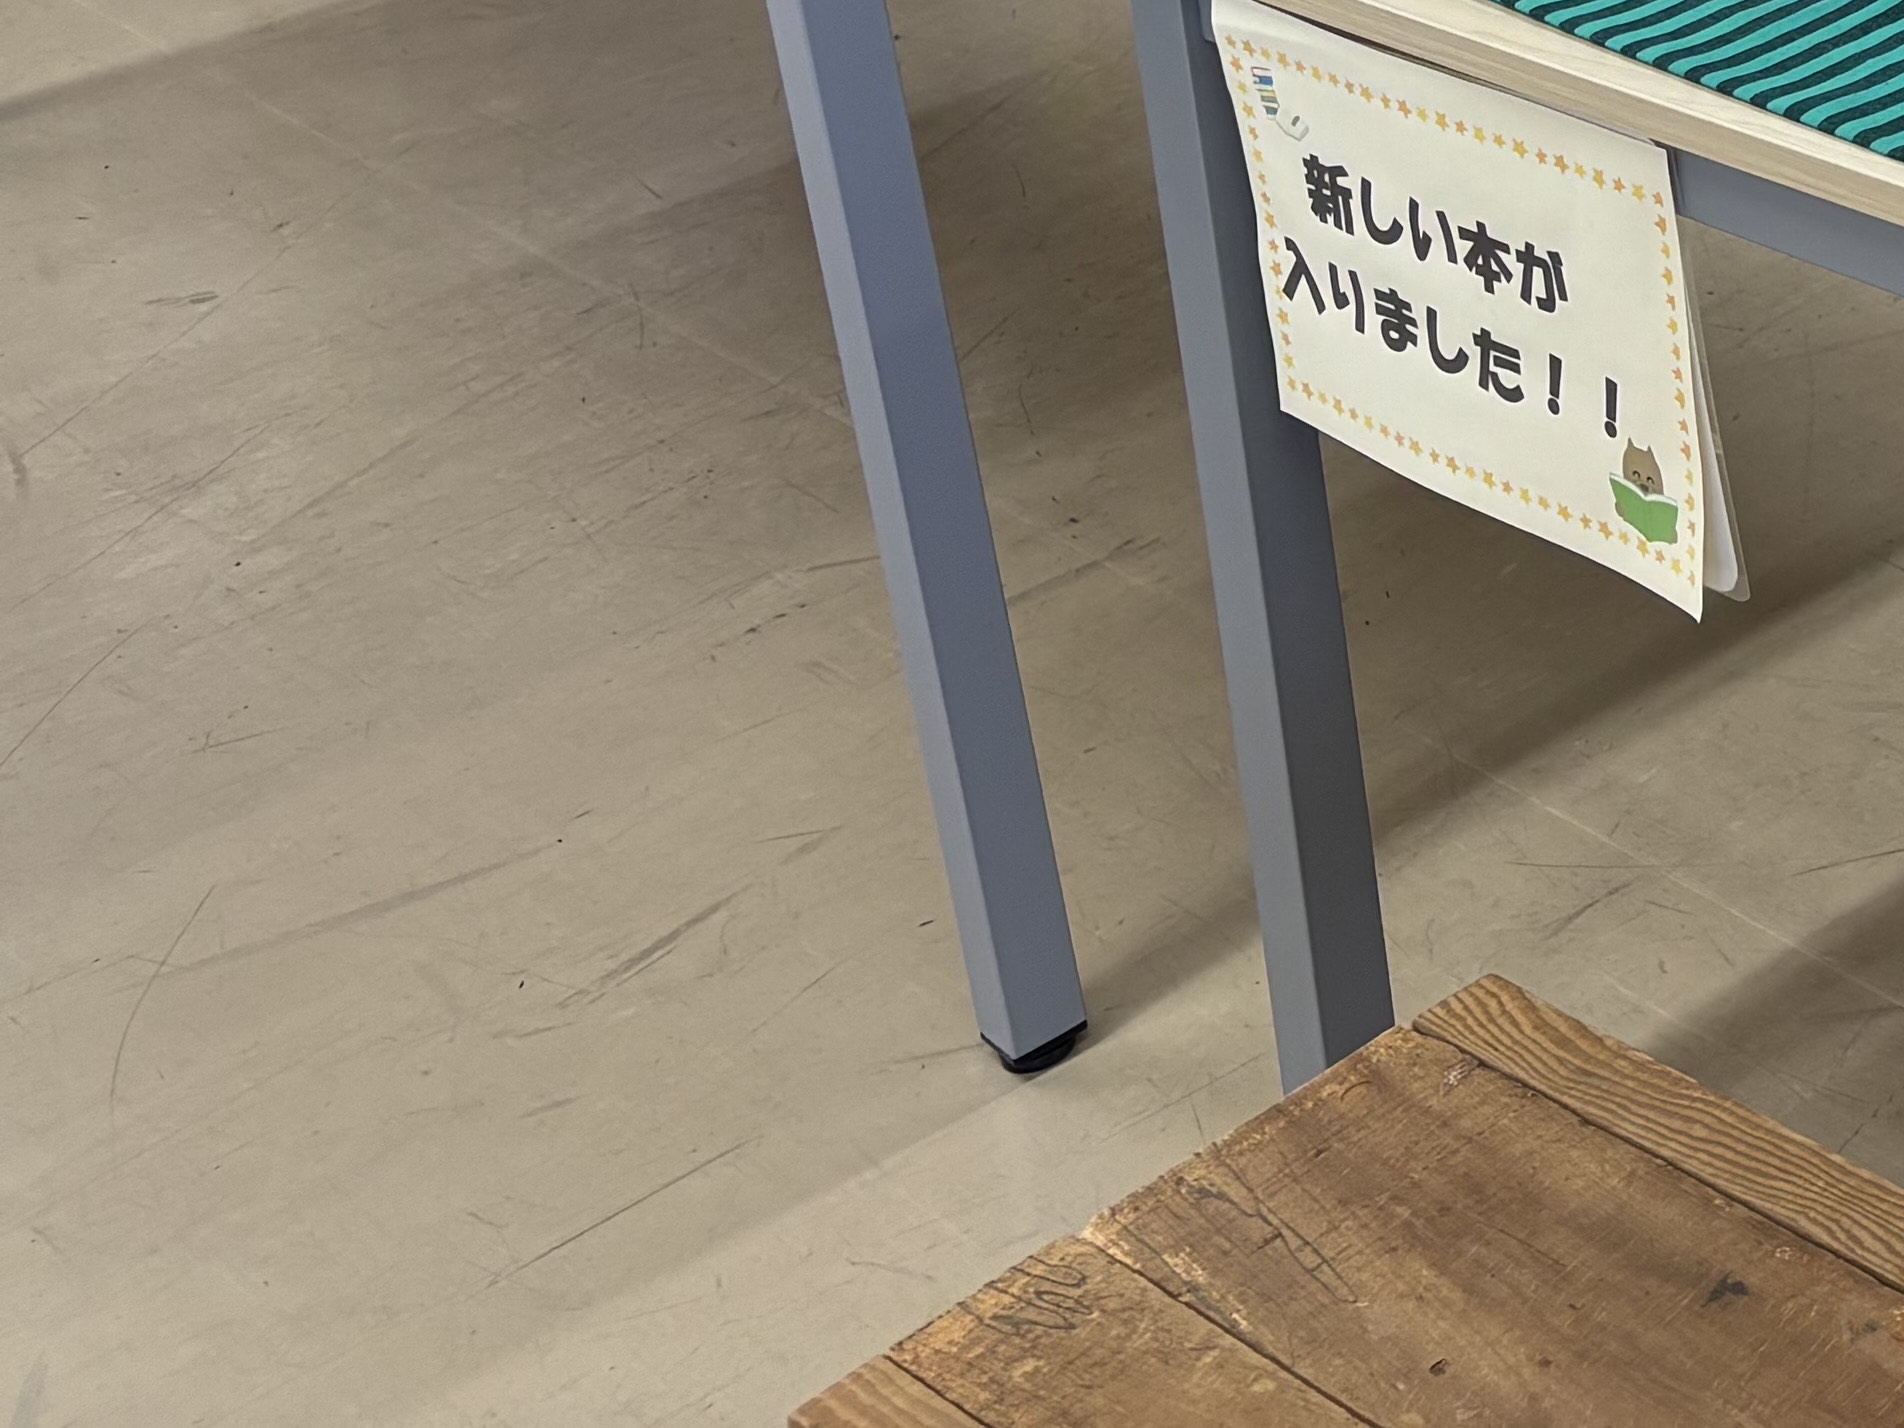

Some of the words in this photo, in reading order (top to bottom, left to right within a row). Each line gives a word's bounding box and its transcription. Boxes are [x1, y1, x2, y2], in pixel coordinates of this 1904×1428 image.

[1301, 153, 1570, 315] 新しい本が
[1281, 235, 1620, 440] 入りました!!
